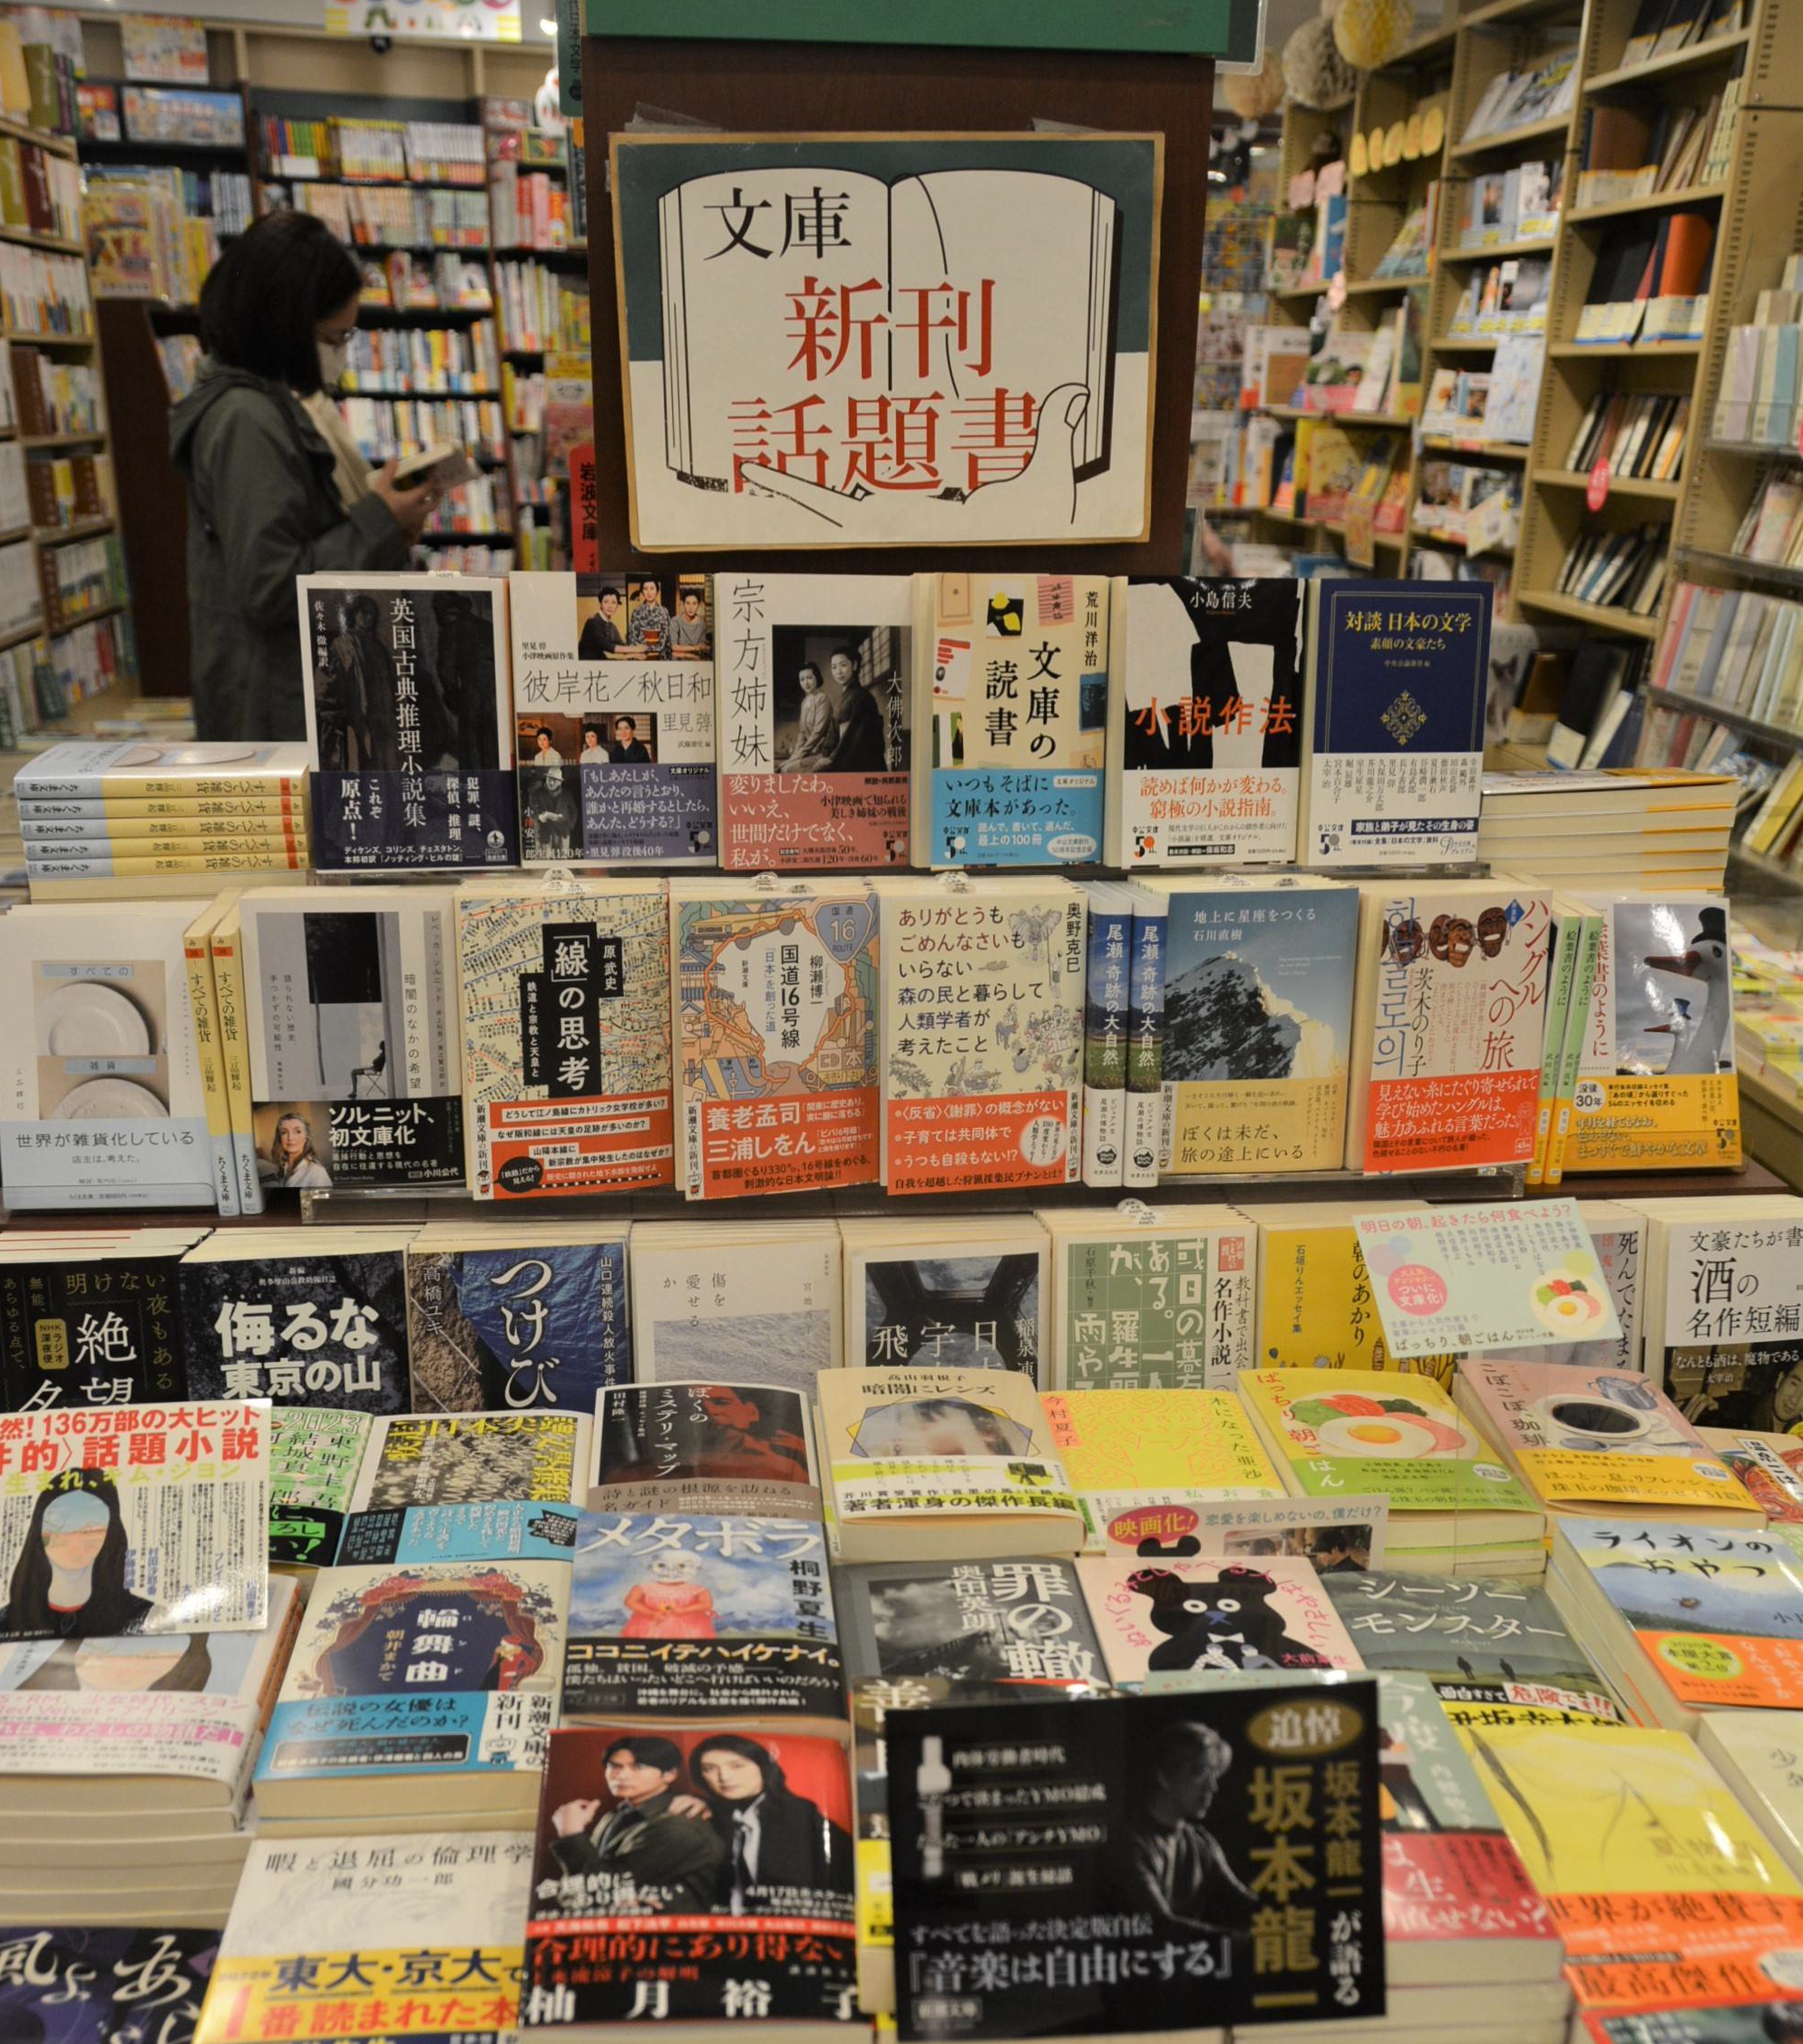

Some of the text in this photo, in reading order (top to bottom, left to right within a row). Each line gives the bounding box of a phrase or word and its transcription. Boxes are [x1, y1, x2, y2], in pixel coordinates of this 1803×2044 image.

[704, 186, 852, 260] 文庫
[784, 277, 996, 382] 新刊
[727, 388, 1039, 493] 話題書
[1190, 590, 1252, 610] 小島信夫
[1085, 590, 1098, 667] 荒川洋治
[1345, 611, 1471, 632] 対談 日本の文学
[1369, 638, 1447, 651] 素顔の文豪たち
[730, 578, 769, 768] 宗方姉妹
[390, 598, 427, 828] 英国古典推理小説集
[986, 660, 1018, 746] 読書
[1027, 640, 1062, 761] 文庫の
[1135, 696, 1294, 736] 小説作法
[887, 671, 902, 767] 大佛次郎
[369, 779, 383, 819] これぞ
[729, 775, 833, 794] 変りましたわ。
[946, 774, 1049, 793] いつもそばに
[1140, 775, 1287, 797] 読めば何かが変わる。
[341, 778, 362, 841] 原点！
[729, 799, 789, 818] いいえ、
[821, 795, 906, 807] 小津映画で知られる
[945, 798, 1076, 818] 文庫本があった。
[1150, 797, 1276, 819] 窮極の小説指南。
[731, 822, 853, 843] 世間だけでなく、
[978, 833, 1042, 846] 最上の100冊
[730, 848, 775, 868] 私が。
[831, 920, 855, 939] 16
[898, 907, 1003, 927] ありがとうも
[1194, 909, 1315, 924] 地上に星座をつくる
[832, 943, 854, 952] ROUTE
[900, 931, 1025, 953] ごめんなさいも
[1066, 901, 1082, 973] 奥野克巳
[1194, 930, 1243, 942] 石川直樹
[603, 944, 618, 991] 原武史
[899, 959, 972, 978] いらない
[1518, 899, 1548, 1011] ハングル
[1557, 930, 1576, 1006] 絵葉書のように
[70, 968, 129, 976] すべての
[810, 955, 824, 1004] 柳瀬博一
[190, 974, 211, 1042] すべての雑貨
[219, 972, 239, 1041] すべての雑貨
[781, 944, 800, 1049] 国道16号線
[898, 981, 1043, 1006] 森の民と暮らして
[527, 981, 540, 1077] 鉄道と宗教と天皇と
[551, 936, 590, 1091] 「線」の思考
[898, 1010, 990, 1031] 人類学者が
[1408, 967, 1433, 1076] 茨木のり子
[1482, 979, 1519, 1071] への旅
[404, 974, 421, 1089] 暗闇のなかの希望
[898, 1037, 988, 1056] 考えたこと
[1379, 1076, 1538, 1103] 見えない糸にたぐり寄せられて
[1576, 1095, 1602, 1107] 30年
[329, 1104, 434, 1125] ソルニット、
[506, 1099, 665, 1119] どうして江ノ島線にカトリック女学校が多い？
[707, 1101, 800, 1132] 養老孟司
[1070, 1092, 1078, 1154] 新潮文庫の新刊
[1376, 1097, 1506, 1121] 学び始めたハングルは、
[15, 1131, 195, 1148] 世界が雑貨化している
[329, 1125, 415, 1146] 初文庫化
[477, 1104, 489, 1170] 新潮文庫の新刊
[498, 1120, 645, 1139] なぜ阪和線には天皇の足跡が多いのか？
[688, 1106, 698, 1170] 新潮文庫の新刊
[903, 1126, 1012, 1145] 子育ては共同体で
[1375, 1114, 1519, 1139] 魅力あふれる言葉だった。
[533, 1145, 575, 1155] 山陽本線に
[549, 1148, 669, 1166] 新宗教が集中発生したのはなぜか？
[707, 1133, 815, 1163] 三浦しをん
[1181, 1144, 1303, 1163] 旅の途上にいる
[218, 1155, 231, 1202] ちくま文庫
[241, 1153, 253, 1201] ちくま文庫
[424, 1167, 459, 1177] 小川公代
[1360, 1205, 1571, 1234] 明日の朝、起きたら何食べよう？
[712, 1272, 726, 1307] 傷を
[1292, 1244, 1306, 1334] 石垣りんエッセイ集
[1398, 1283, 1435, 1294] ついに
[1691, 1258, 1759, 1304] 酒の
[423, 1264, 443, 1334] 高橋ユキ
[686, 1272, 700, 1329] 愛せる
[1398, 1293, 1444, 1307] 文庫化！
[4, 1278, 24, 1370] あらゆる点で、
[39, 1323, 62, 1332] NHK
[214, 1298, 379, 1358] 侮るな
[491, 1260, 560, 1408] つけび
[599, 1257, 616, 1387] 山口連続殺人放火事件
[1687, 1304, 1803, 1338] 名作短編
[41, 1333, 54, 1366] 深夜便
[53, 1333, 65, 1364] ラジオ
[221, 1356, 381, 1400] 東京の山
[862, 1383, 996, 1396] 暗闇にレンズ
[613, 1391, 626, 1423] 田村隆一
[688, 1387, 710, 1423] ぼくの
[1047, 1395, 1080, 1446] 今村夏子
[286, 1414, 362, 1436] 2023
[655, 1388, 681, 1478] ミステリ・マップ
[602, 1484, 792, 1500] 詩と謎の根源を訪ねる
[603, 1499, 671, 1513] 名ガイド
[843, 1496, 1077, 1513] 著者渾身の傑作長編
[1114, 1514, 1194, 1537] 映画化！
[1205, 1505, 1381, 1526] 恋愛を楽しめないの、僕だけ？
[577, 1518, 821, 1561] メタボラ
[1593, 1532, 1773, 1553] ライオンの
[1641, 1558, 1766, 1579] おやつ
[790, 1559, 828, 1640] 桐野夏生
[950, 1564, 996, 1631] 奥田英朗
[1360, 1578, 1530, 1603] シーソー
[992, 1563, 1101, 1684] 罪の轍
[1353, 1612, 1568, 1638] モンスター
[378, 1629, 404, 1681] 朝井まかて
[404, 1609, 460, 1683] 輪舞曲
[568, 1643, 840, 1669] ココニイテハイケナイ。
[307, 1700, 458, 1718] 伝説の女優は
[495, 1695, 521, 1730] 新刊
[288, 1715, 468, 1736] なぜ死んだのか？
[1268, 1708, 1341, 1748] 追悼
[266, 1845, 533, 1874] 暇と退屈の倫理学
[332, 1874, 453, 1890] 國分功一郎
[1248, 1765, 1319, 2008] 坂本龍一
[911, 1913, 1154, 1945] すべてを語った決定版自伝
[532, 1935, 843, 1967] 合理的にあり得ない
[911, 1935, 1233, 1993] 『音楽は自由にする』
[269, 1949, 528, 1992] 東大・京大で
[526, 1980, 860, 2024] 柚月裕子
